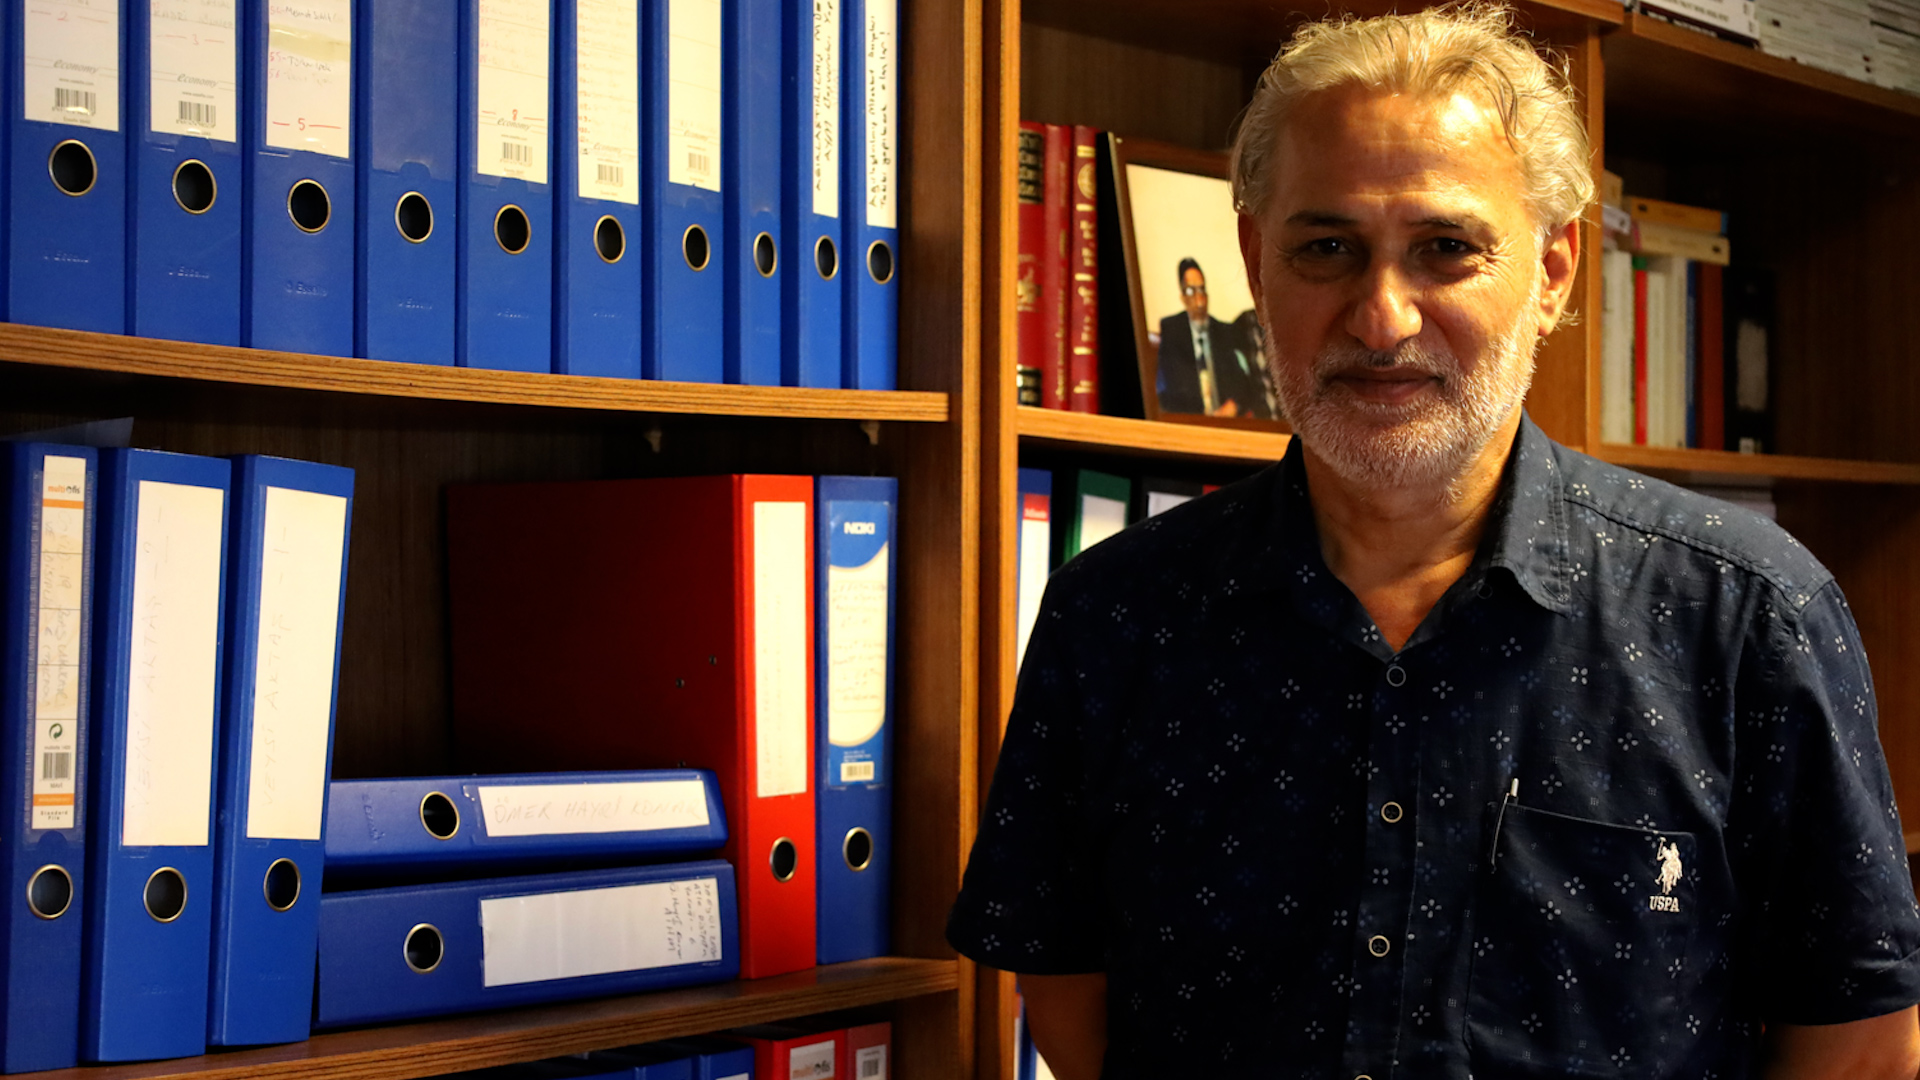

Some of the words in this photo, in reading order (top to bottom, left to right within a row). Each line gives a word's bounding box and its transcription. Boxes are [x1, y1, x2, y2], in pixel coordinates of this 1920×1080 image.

[53, 58, 99, 75] economy
[176, 72, 219, 89] economy
[296, 117, 306, 131] 5
[497, 117, 531, 132] economy
[493, 795, 553, 824] ÖMER
[1649, 896, 1681, 913] USPA
